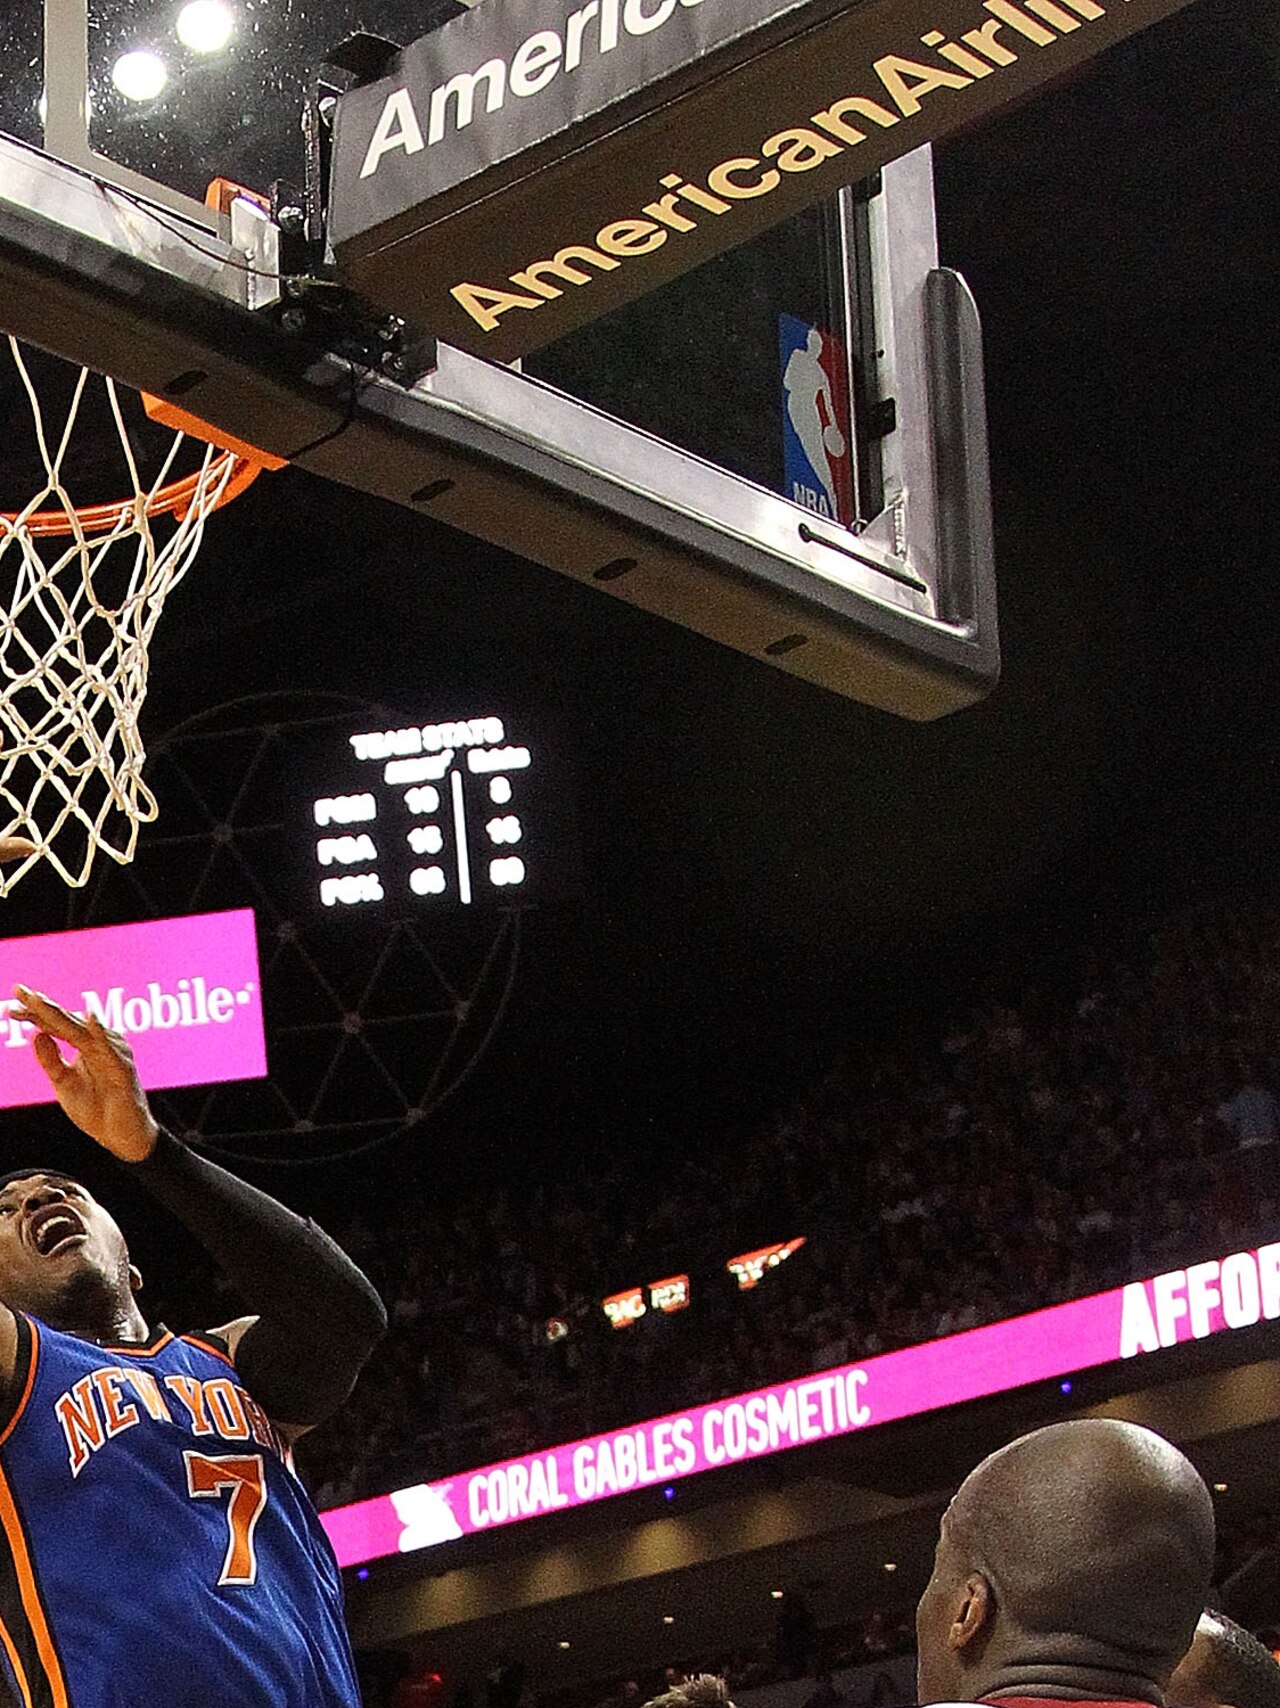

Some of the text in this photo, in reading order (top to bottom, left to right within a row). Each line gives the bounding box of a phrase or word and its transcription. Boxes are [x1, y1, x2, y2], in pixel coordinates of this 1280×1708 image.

[360, 0, 705, 178] Americ
[55, 1367, 172, 1478] NEW
[468, 1368, 871, 1528] CORAL GABLES COSMETIC
[183, 1450, 267, 1586] 7
